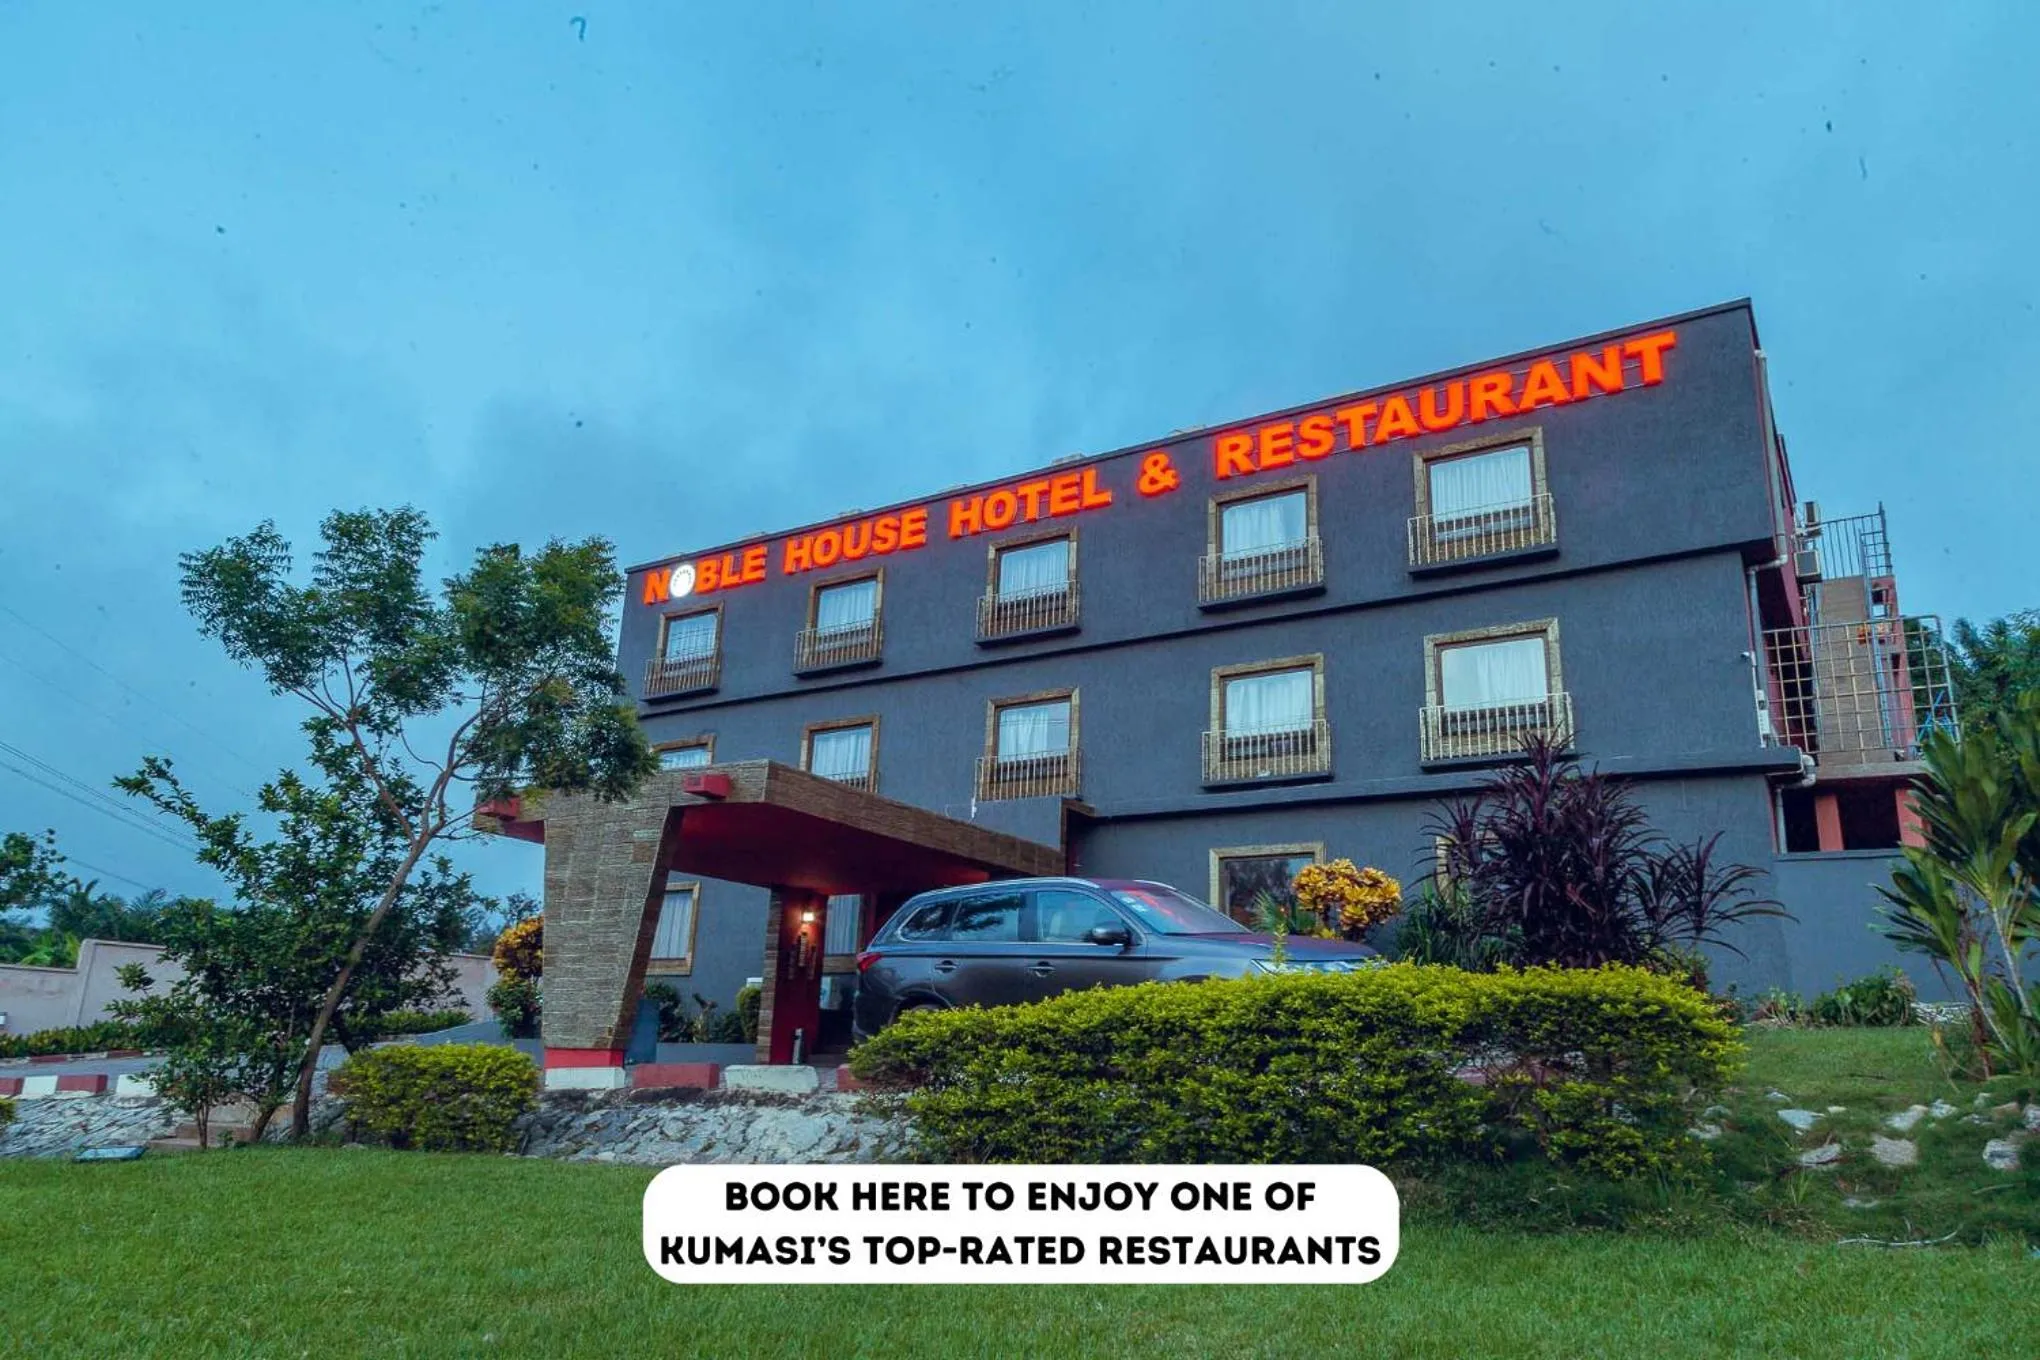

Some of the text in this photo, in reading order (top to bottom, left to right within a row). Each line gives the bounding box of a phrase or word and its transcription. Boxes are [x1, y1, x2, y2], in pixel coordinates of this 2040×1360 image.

[783, 507, 928, 575] HOUSE
[948, 467, 1112, 538] HOTEL
[1136, 450, 1180, 497] &
[1214, 331, 1678, 480] RESTAURANT
